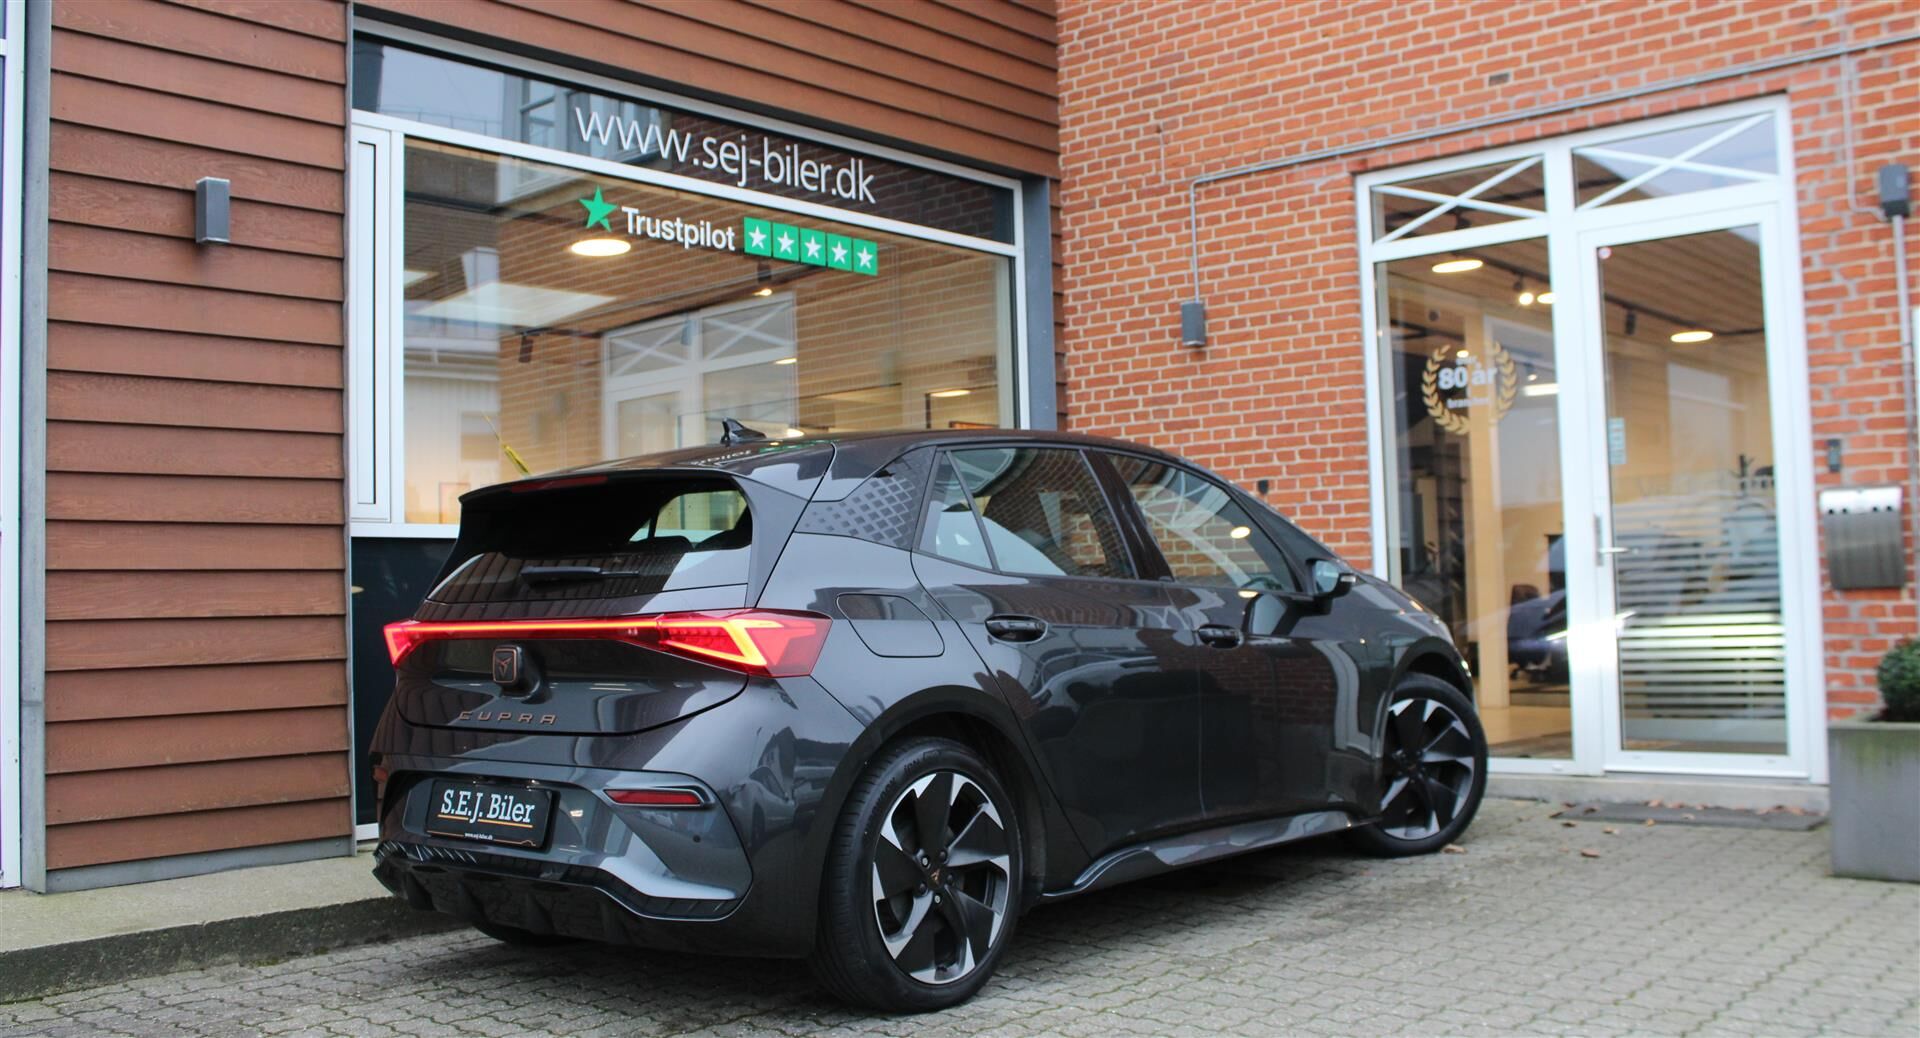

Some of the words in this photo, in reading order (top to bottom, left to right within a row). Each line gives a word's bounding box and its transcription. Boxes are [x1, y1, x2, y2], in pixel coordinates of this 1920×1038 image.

[575, 107, 876, 204] www.sej-biler.dk
[621, 206, 736, 250] Trustpilot
[1438, 366, 1468, 390] 80
[459, 711, 557, 725] CUPRA
[440, 789, 483, 824] S.E.J.
[487, 794, 535, 823] Biler
